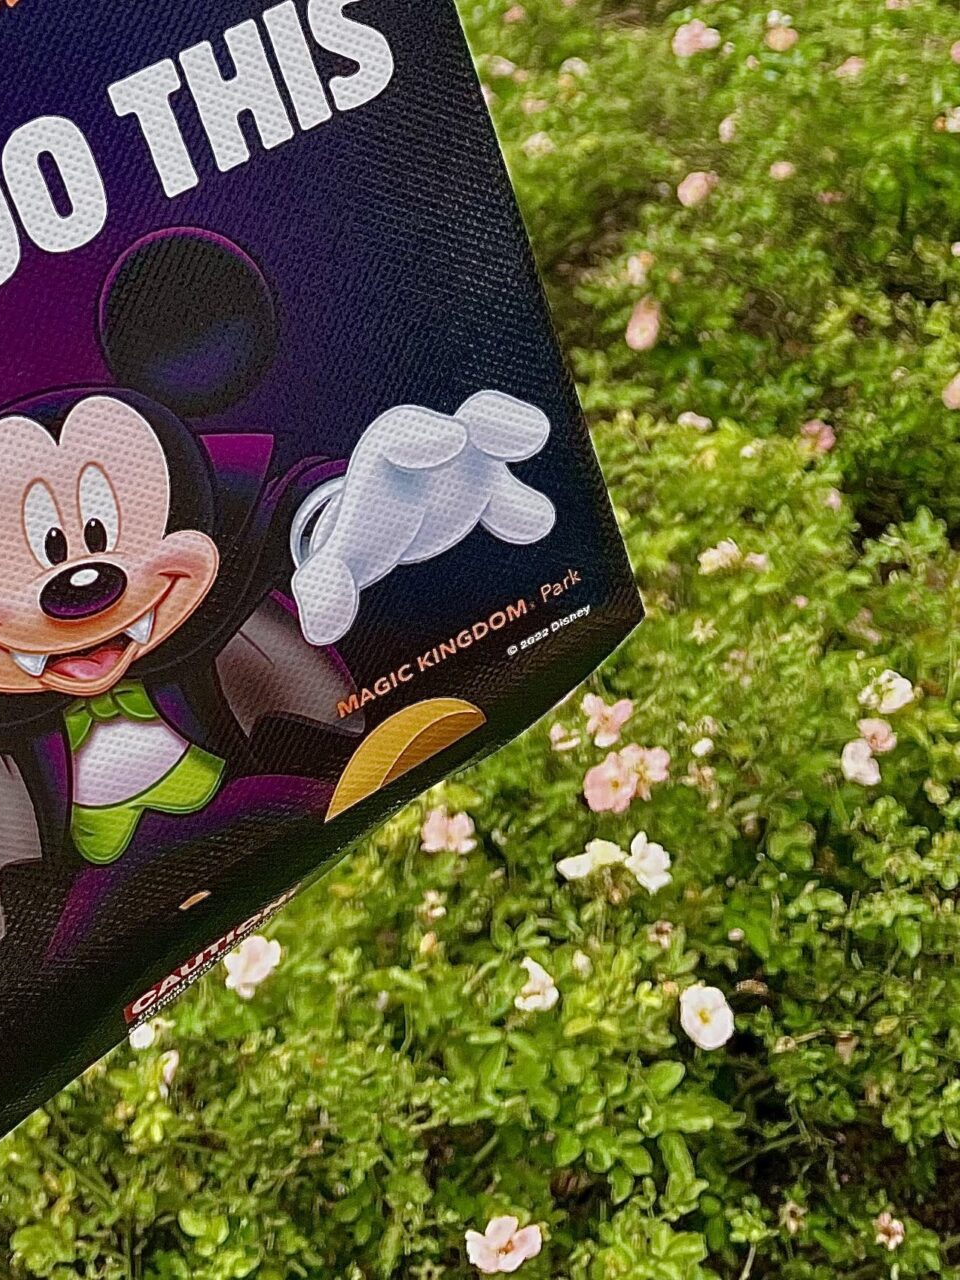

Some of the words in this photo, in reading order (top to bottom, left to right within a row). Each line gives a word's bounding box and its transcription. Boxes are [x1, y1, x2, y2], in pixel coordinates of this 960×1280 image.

[336, 663, 415, 718] MAGIC
[540, 568, 583, 603] Park
[520, 627, 549, 650] 2022
[550, 604, 591, 632] Disney
